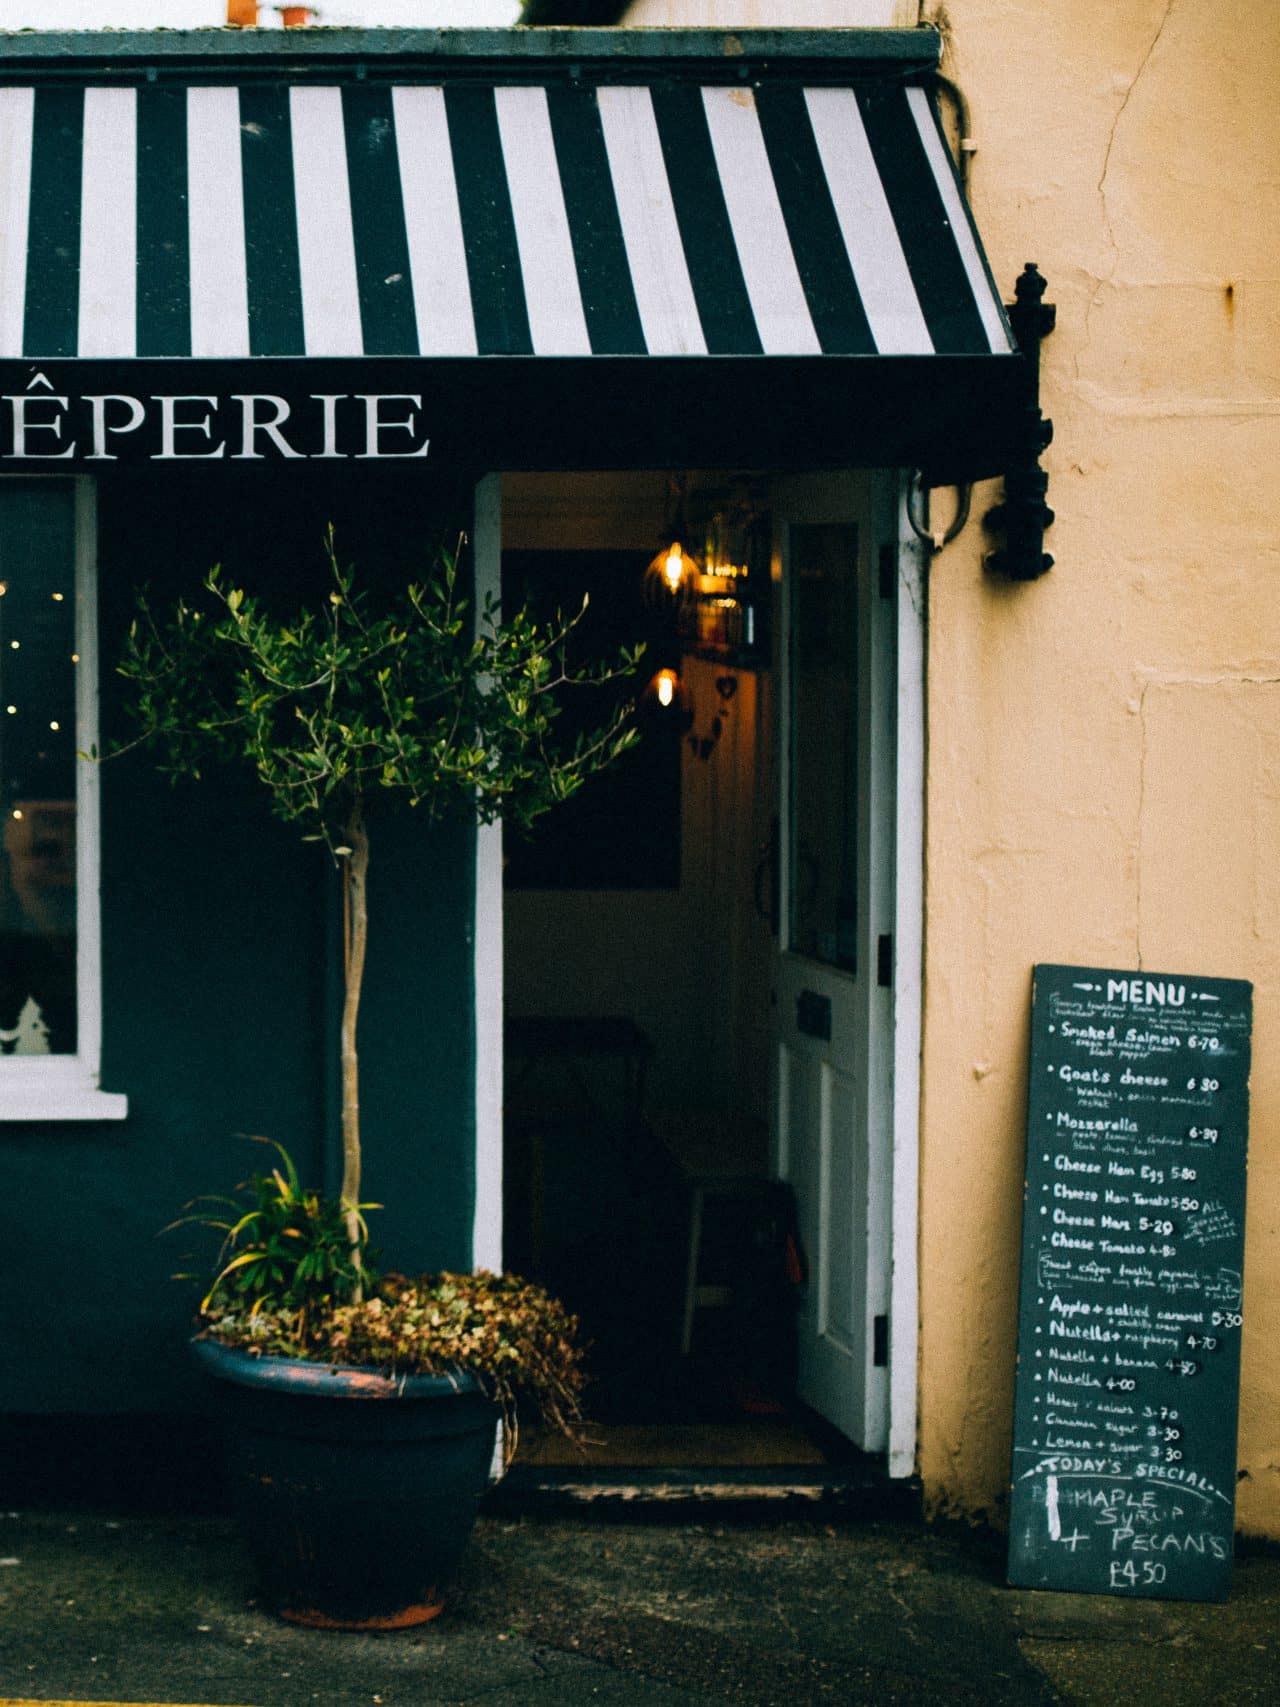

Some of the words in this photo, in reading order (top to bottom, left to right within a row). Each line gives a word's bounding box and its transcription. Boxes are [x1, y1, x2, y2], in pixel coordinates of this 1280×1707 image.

[1107, 979, 1186, 1007] MENU
[1061, 1021, 1116, 1041] Smoked
[1125, 1028, 1181, 1048] Salmon
[1120, 1067, 1169, 1087] cheese
[1057, 1112, 1139, 1132] Mozzarella
[1054, 1154, 1102, 1174] Cheese
[1108, 1161, 1135, 1177] Ham
[1140, 1165, 1164, 1183] Egg
[1053, 1182, 1099, 1201] Cheese
[1053, 1208, 1096, 1227] Cheese
[1051, 1231, 1095, 1251] Cheese
[1099, 1239, 1146, 1255] Tomato
[1049, 1294, 1091, 1319] Apple
[1157, 1310, 1204, 1323] caramel
[1049, 1319, 1111, 1342] Nutella
[1049, 1348, 1096, 1363] Nutella
[1115, 1352, 1159, 1369] banana
[1048, 1367, 1102, 1388] Nutella
[1046, 1393, 1079, 1411] Honey
[1105, 1422, 1139, 1437] sugar
[1046, 1432, 1092, 1450] Lemon
[1109, 1443, 1144, 1456] sugar
[1041, 1457, 1122, 1473] TODAY'S
[1135, 1463, 1211, 1490] SPECIAL
[1074, 1489, 1158, 1508] MAPLE
[1112, 1528, 1226, 1560] PECANS
